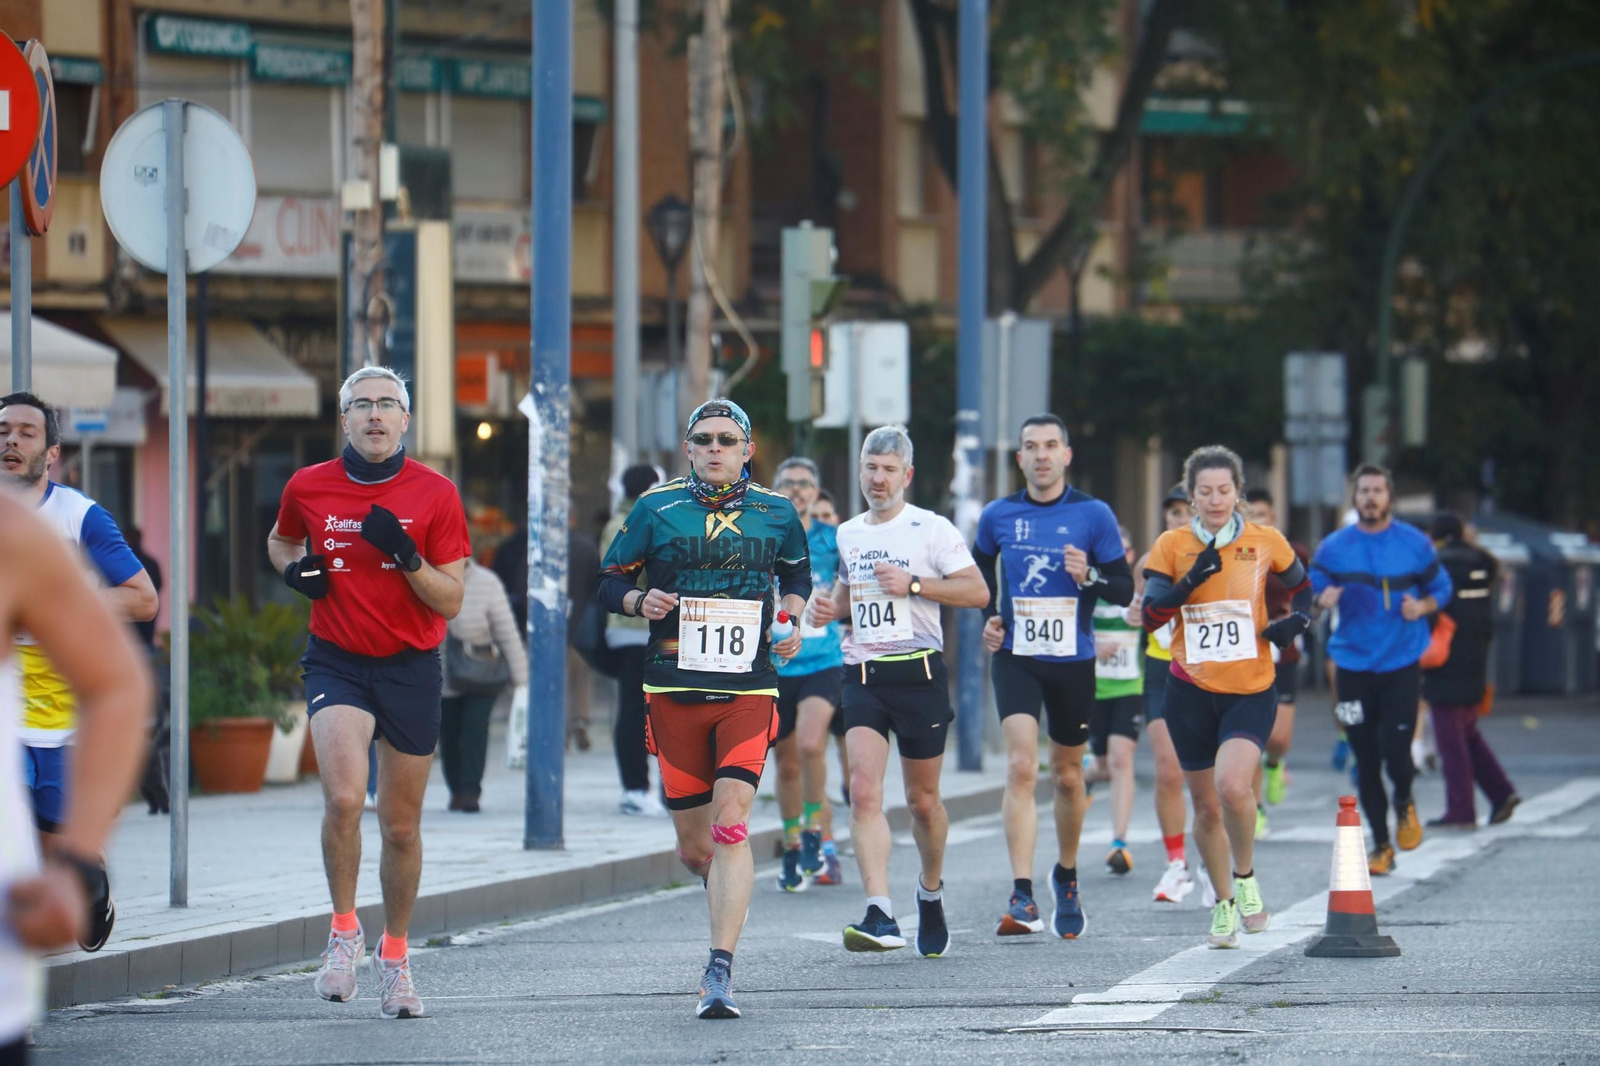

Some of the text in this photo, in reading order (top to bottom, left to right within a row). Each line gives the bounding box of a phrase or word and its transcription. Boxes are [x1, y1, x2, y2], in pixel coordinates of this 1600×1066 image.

[333, 519, 362, 529] califas
[705, 510, 744, 544] IX
[669, 536, 776, 565] SUBIDA
[859, 556, 909, 572] MATÓN
[860, 550, 889, 561] MEDIA
[675, 569, 770, 596] ERMITAS
[683, 601, 707, 622] XLI
[858, 601, 897, 629] 204
[697, 624, 745, 656] 118
[1025, 618, 1064, 642] 840
[1198, 620, 1240, 649] 279
